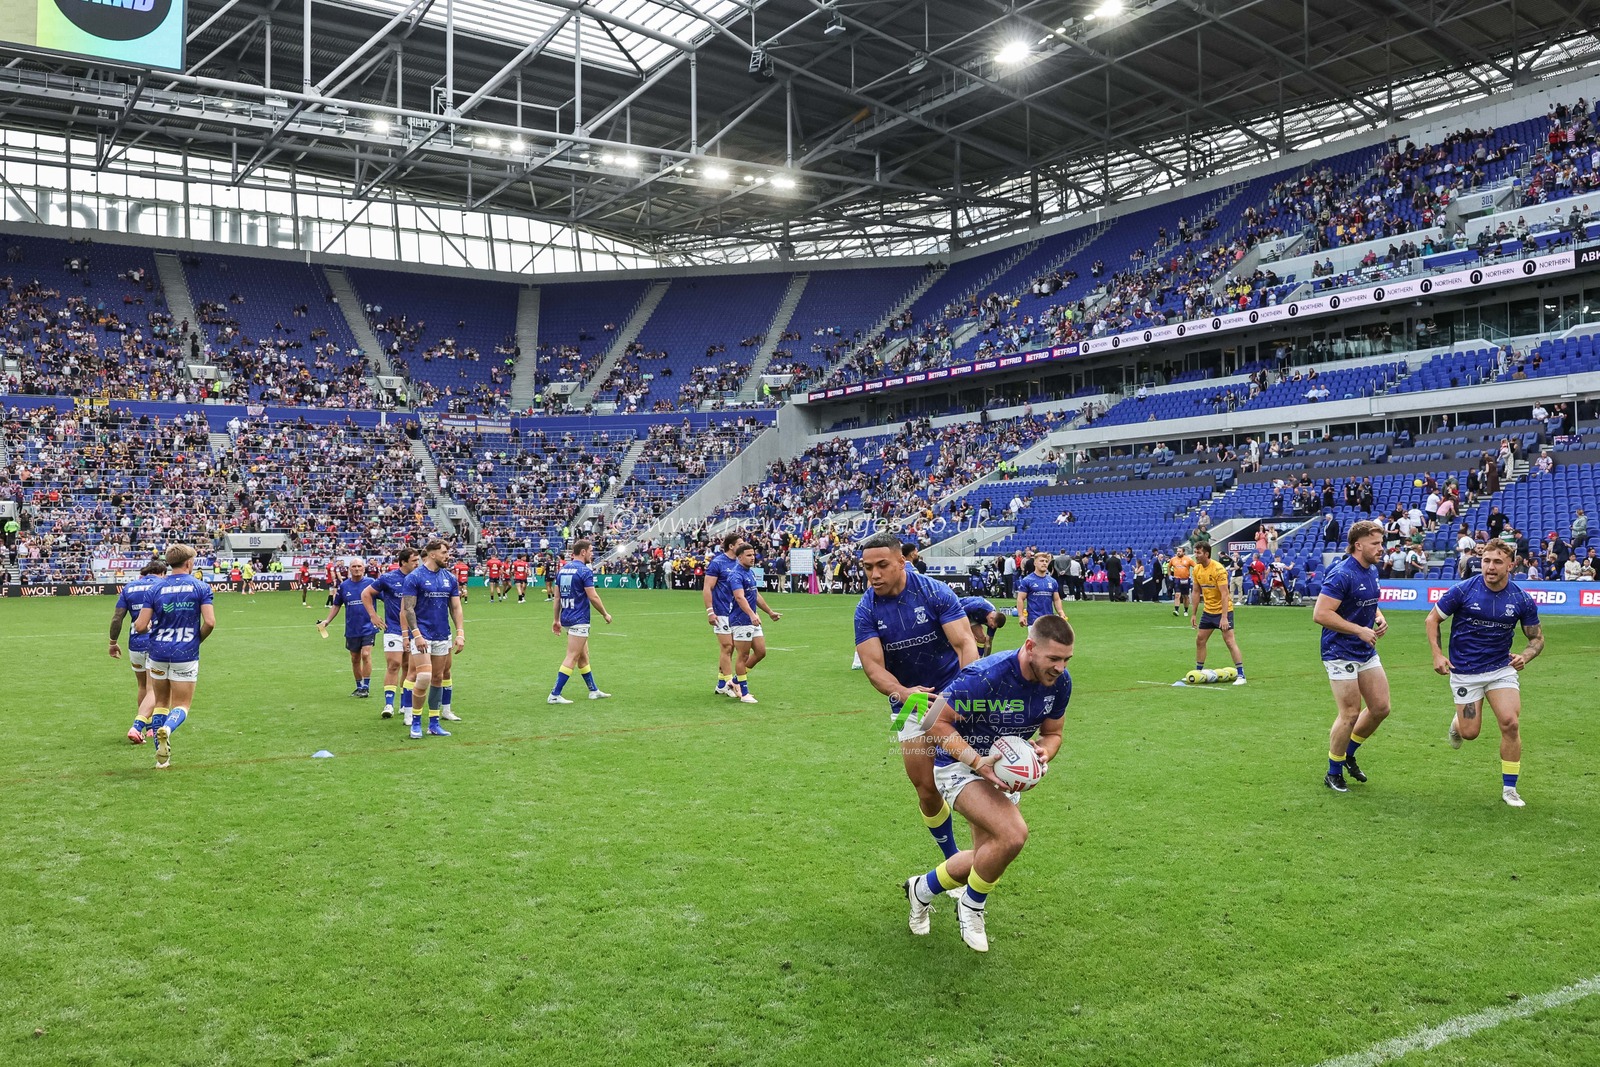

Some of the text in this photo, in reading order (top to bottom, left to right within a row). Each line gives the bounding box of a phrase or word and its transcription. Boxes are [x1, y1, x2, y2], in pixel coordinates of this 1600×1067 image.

[1539, 258, 1570, 268] NORTHERN
[1485, 268, 1514, 278] NORTHERN
[1434, 278, 1462, 286] NORTHERN
[1387, 286, 1413, 295] NORTHERN
[1342, 294, 1367, 303] NORTHERN
[1300, 302, 1323, 311] NORTHERN
[1261, 310, 1282, 318] NORTHERN
[1025, 351, 1049, 362] BETFRED
[1053, 346, 1077, 357] BETFRED
[975, 361, 996, 371] BETFRED
[1000, 356, 1022, 367] BETFRED
[951, 366, 972, 376] BETFRED
[27, 586, 58, 595] WOLF
[75, 585, 105, 594] WOLF
[211, 583, 238, 591] WOLF
[253, 582, 280, 590] WOLF
[1379, 588, 1417, 600] TFRED
[1531, 591, 1567, 603] FRED
[886, 631, 938, 651] ASHBROOK
[995, 739, 1019, 764] ETFRED
